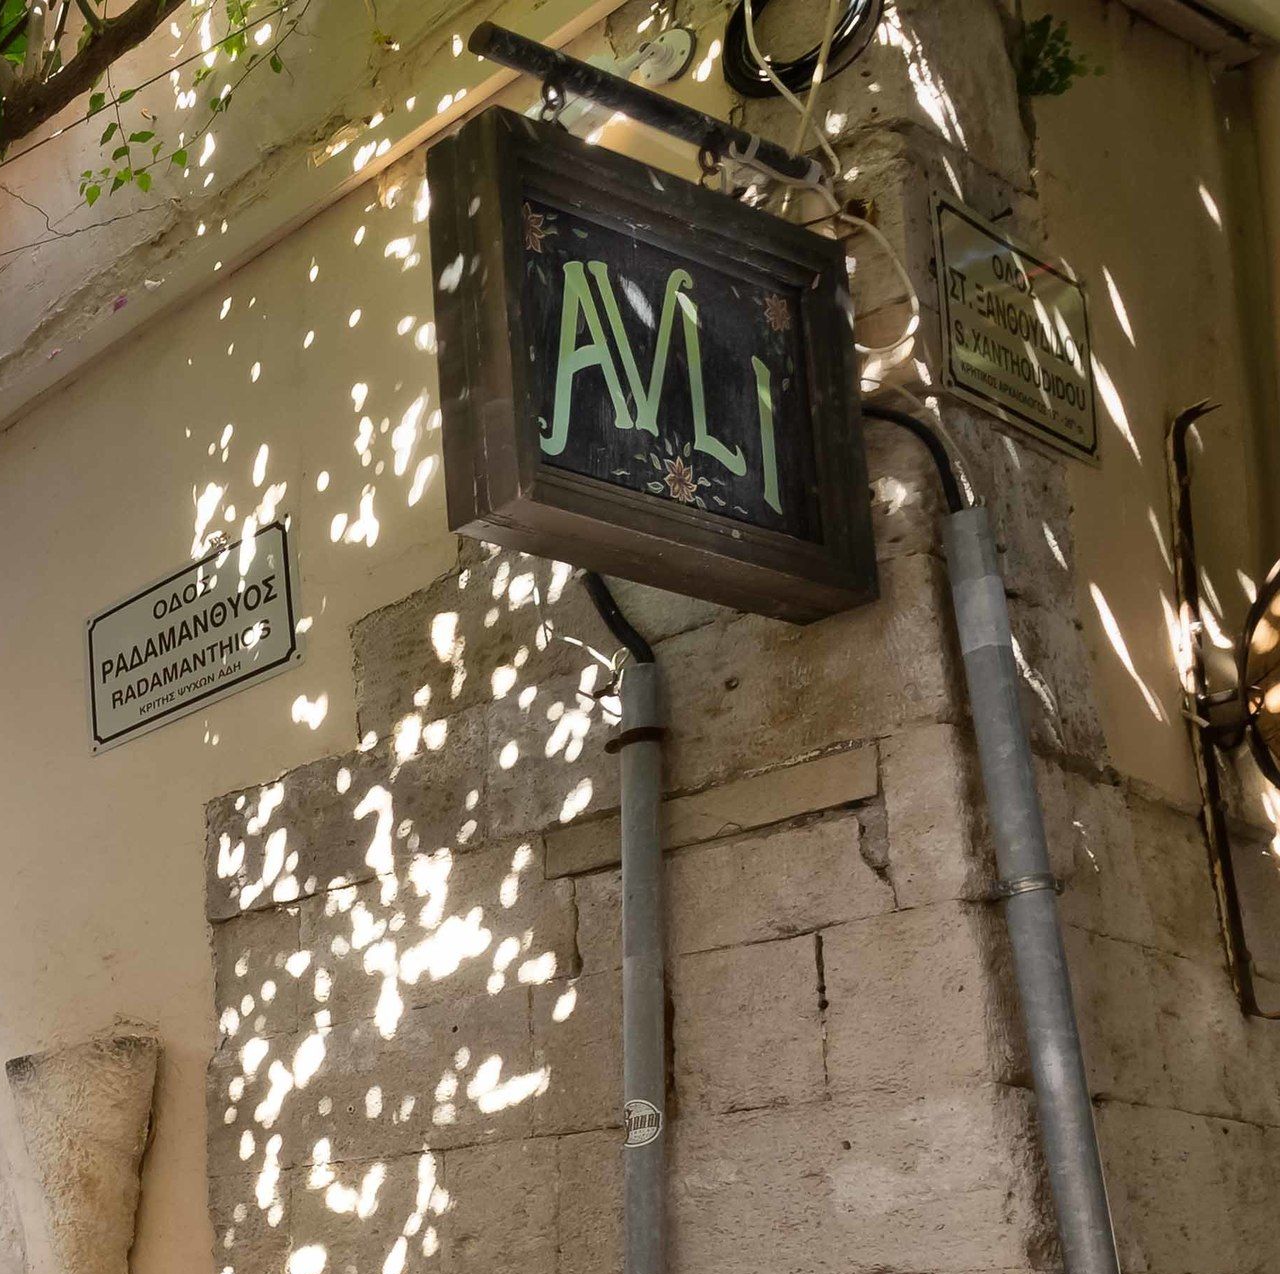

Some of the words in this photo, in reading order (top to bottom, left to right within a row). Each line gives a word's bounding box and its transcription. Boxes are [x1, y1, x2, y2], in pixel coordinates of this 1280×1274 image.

[949, 265, 974, 309] ΣΤ.
[992, 253, 1036, 299] ΟΔΟΣ
[538, 260, 783, 516] AVLI
[954, 319, 969, 350] S.
[972, 327, 1087, 412] XANTHOUDIDOU
[101, 574, 278, 684] ΡΑΔΑΜΑΝΘΥΟΣ
[153, 574, 213, 620] ΟΔΟΣ
[111, 619, 272, 710] RADAMANTHIOS
[139, 691, 176, 715] ΚΡΙΤΗΣ
[177, 672, 216, 697] ΨΥΧΩΝ
[217, 661, 242, 681] ΑΔΗ
